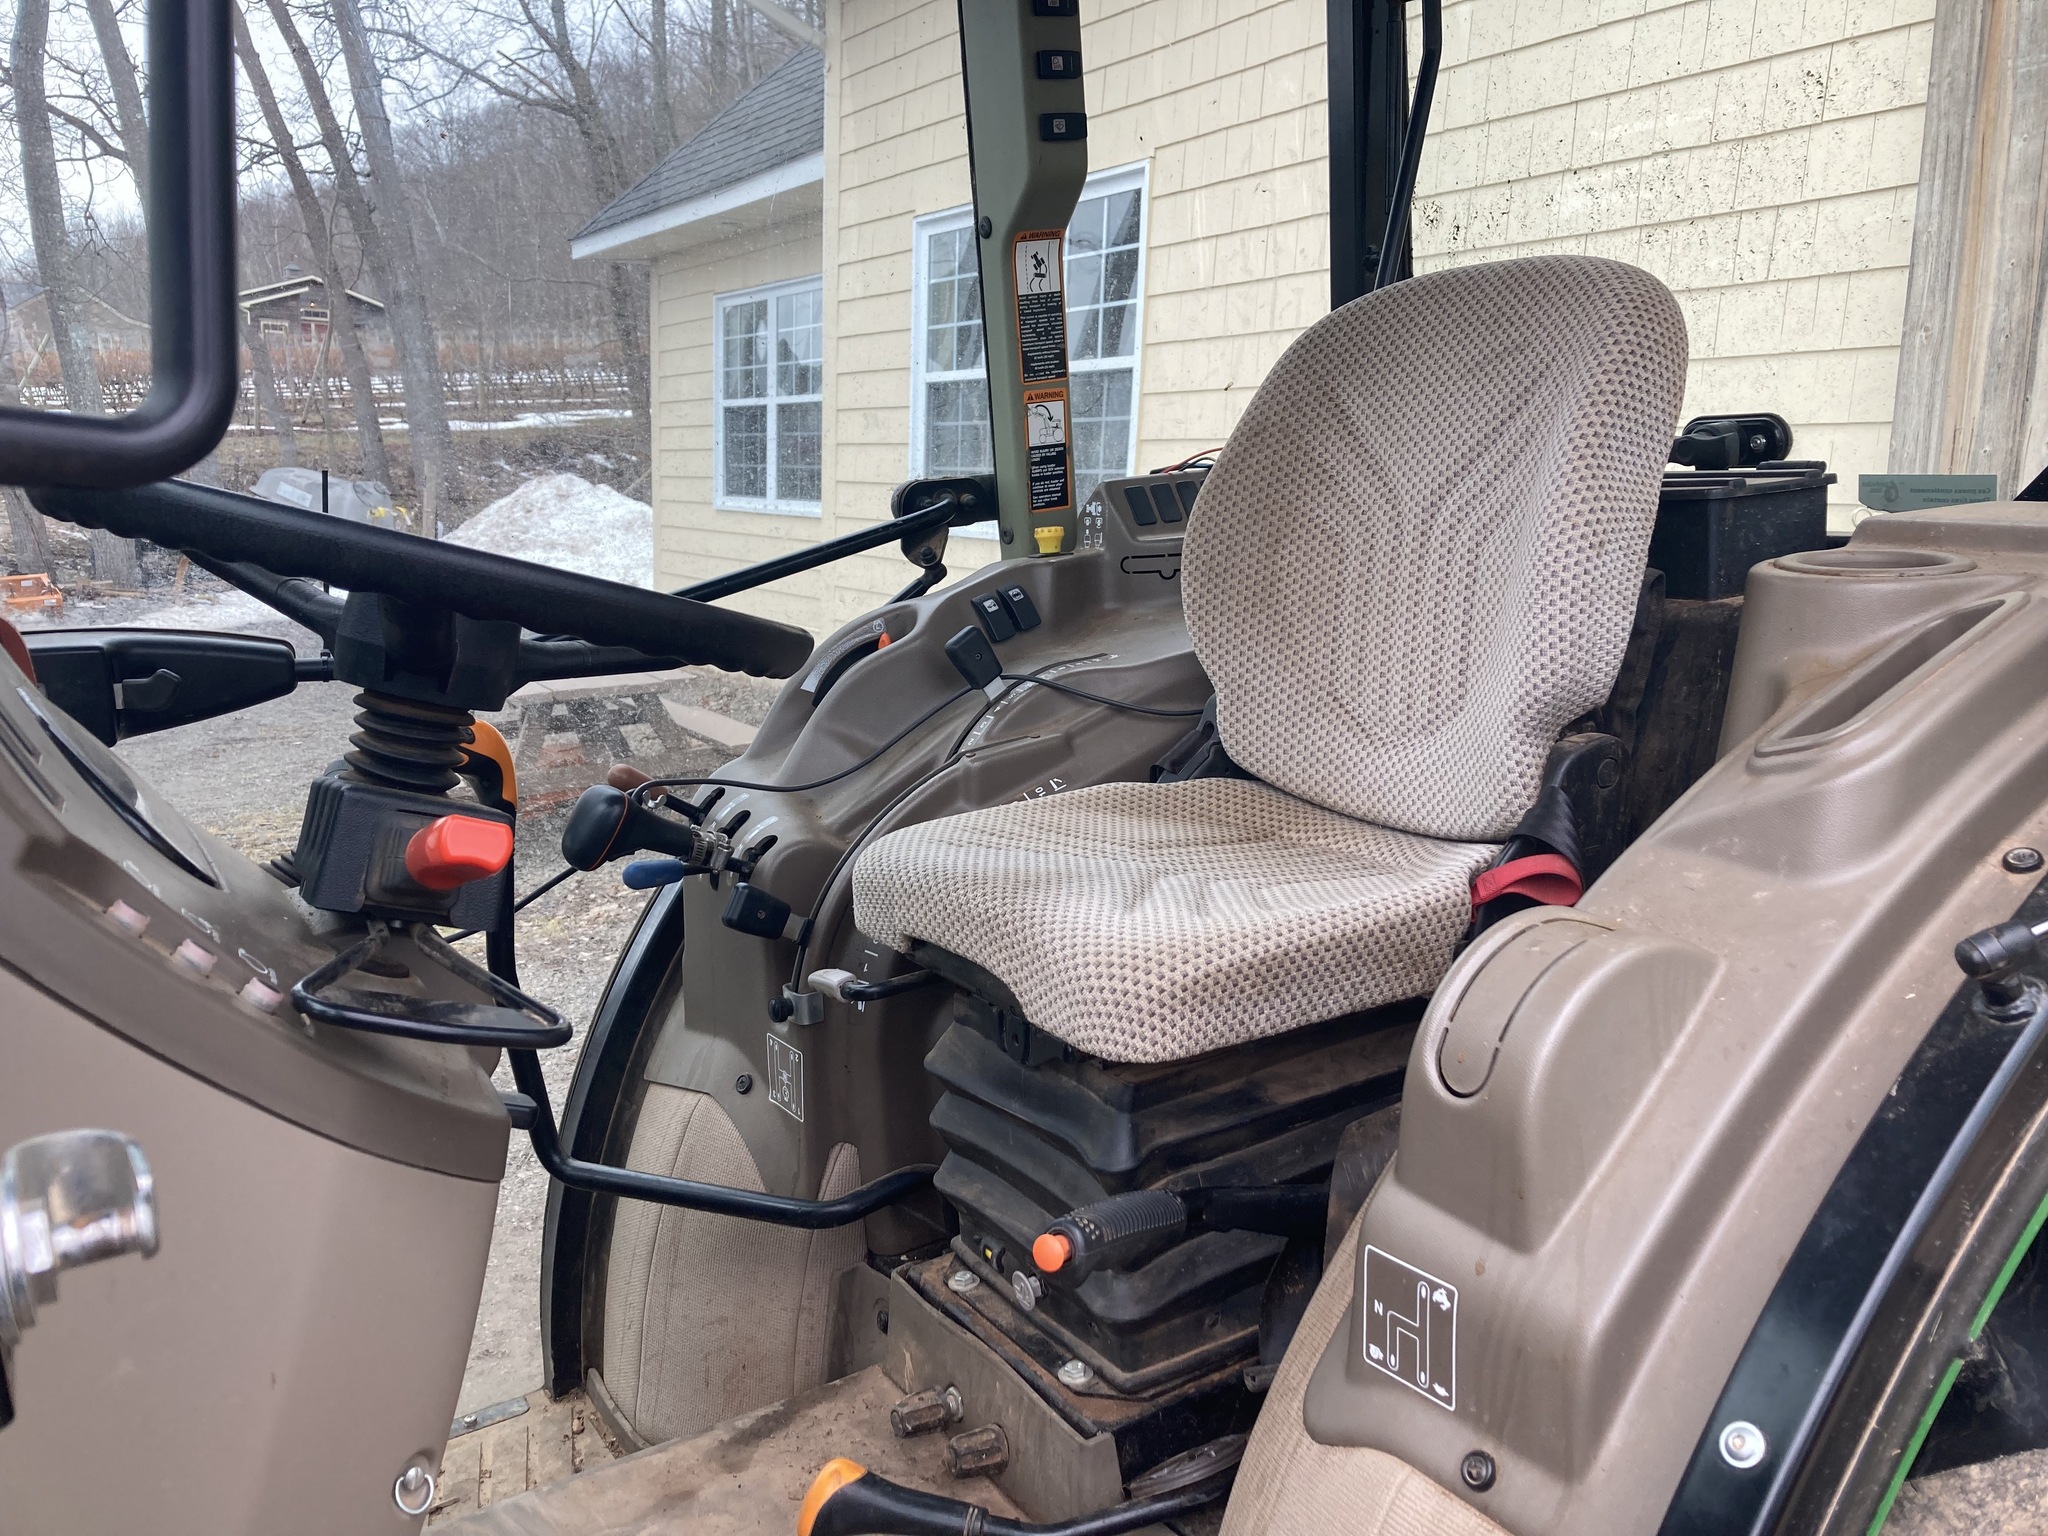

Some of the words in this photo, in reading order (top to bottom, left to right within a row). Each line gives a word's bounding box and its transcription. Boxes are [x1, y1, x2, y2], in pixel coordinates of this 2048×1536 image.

[1028, 230, 1061, 239] WARNING
[1034, 390, 1064, 400] WARNING
[1374, 1299, 1383, 1316] N
